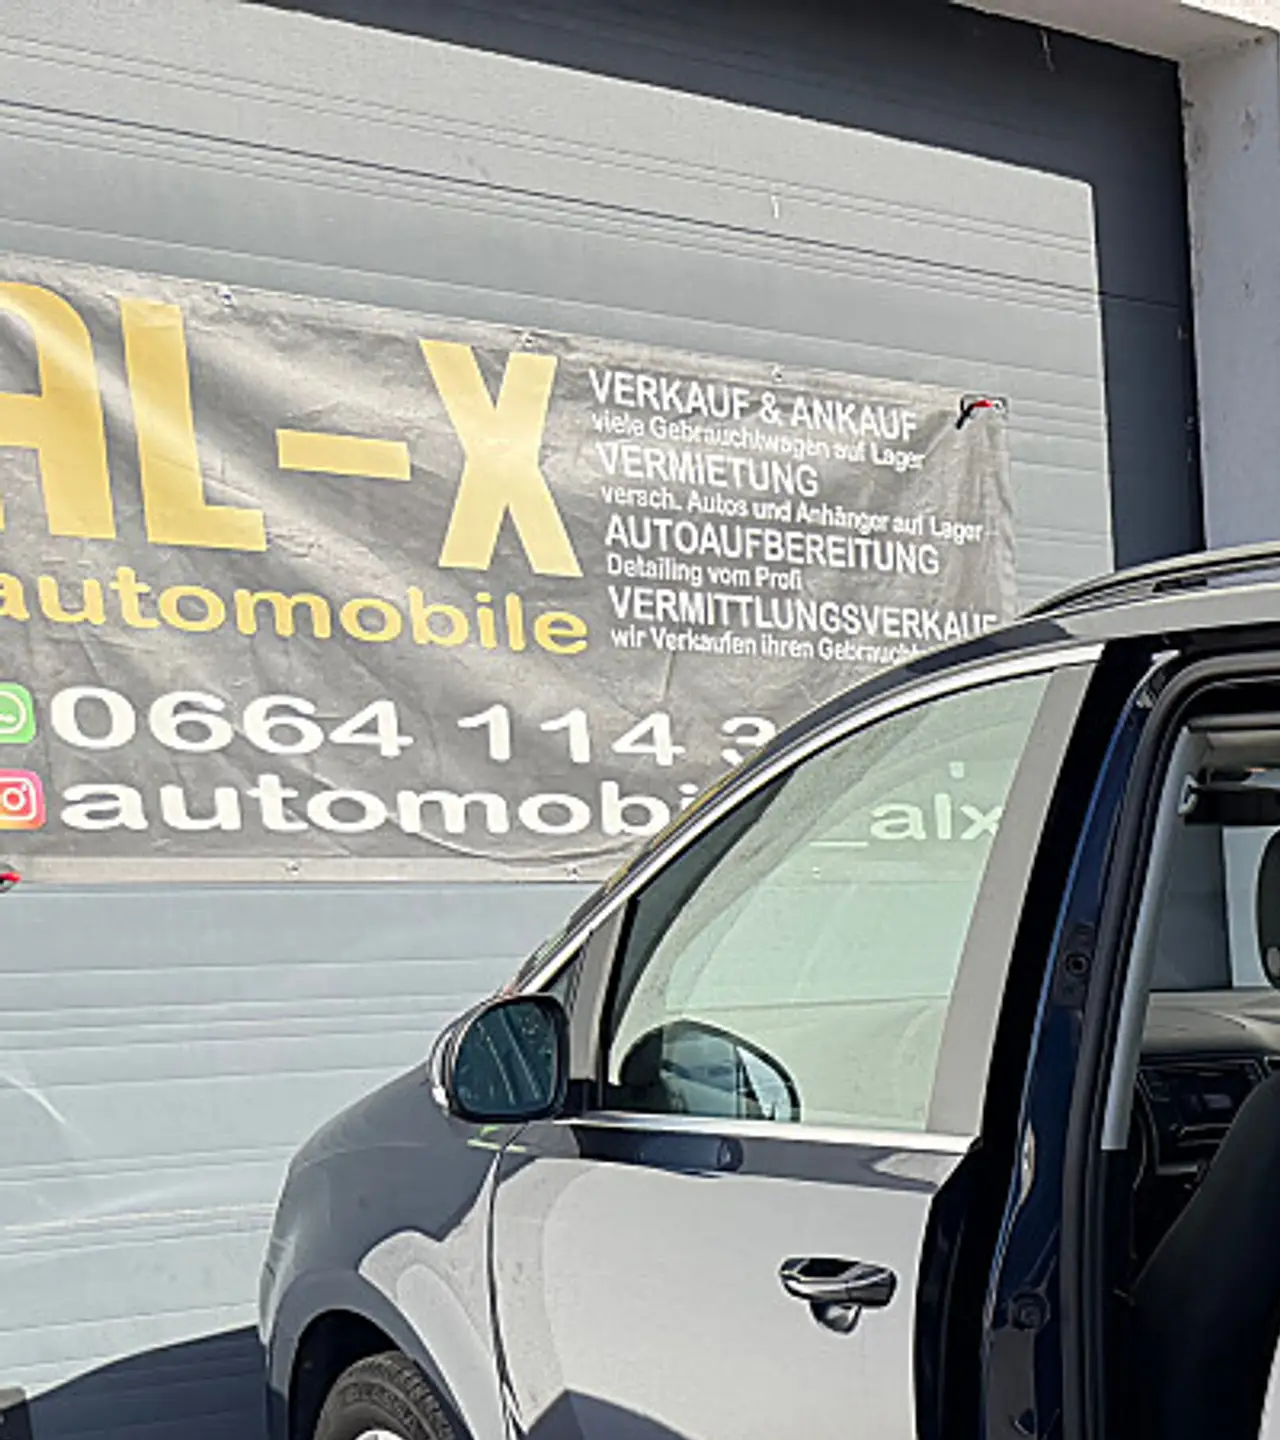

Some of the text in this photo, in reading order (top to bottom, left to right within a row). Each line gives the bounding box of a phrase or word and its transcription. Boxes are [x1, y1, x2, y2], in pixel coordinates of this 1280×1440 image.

[588, 368, 917, 442] VERKAUF & ANKAUF
[591, 411, 925, 472] viele Gebrauchtwagen auf Lager
[595, 441, 819, 498] VERMIETUNG
[600, 485, 984, 545] versch. Autos und Anhänger auf Lager
[605, 514, 940, 575] AUTOAUFBEREITUNG
[607, 553, 802, 591] Detailing vom Profi
[610, 626, 646, 649] wir
[651, 627, 756, 654] Verkaufen
[762, 632, 815, 658] ihren
[50, 687, 414, 758] 0664
